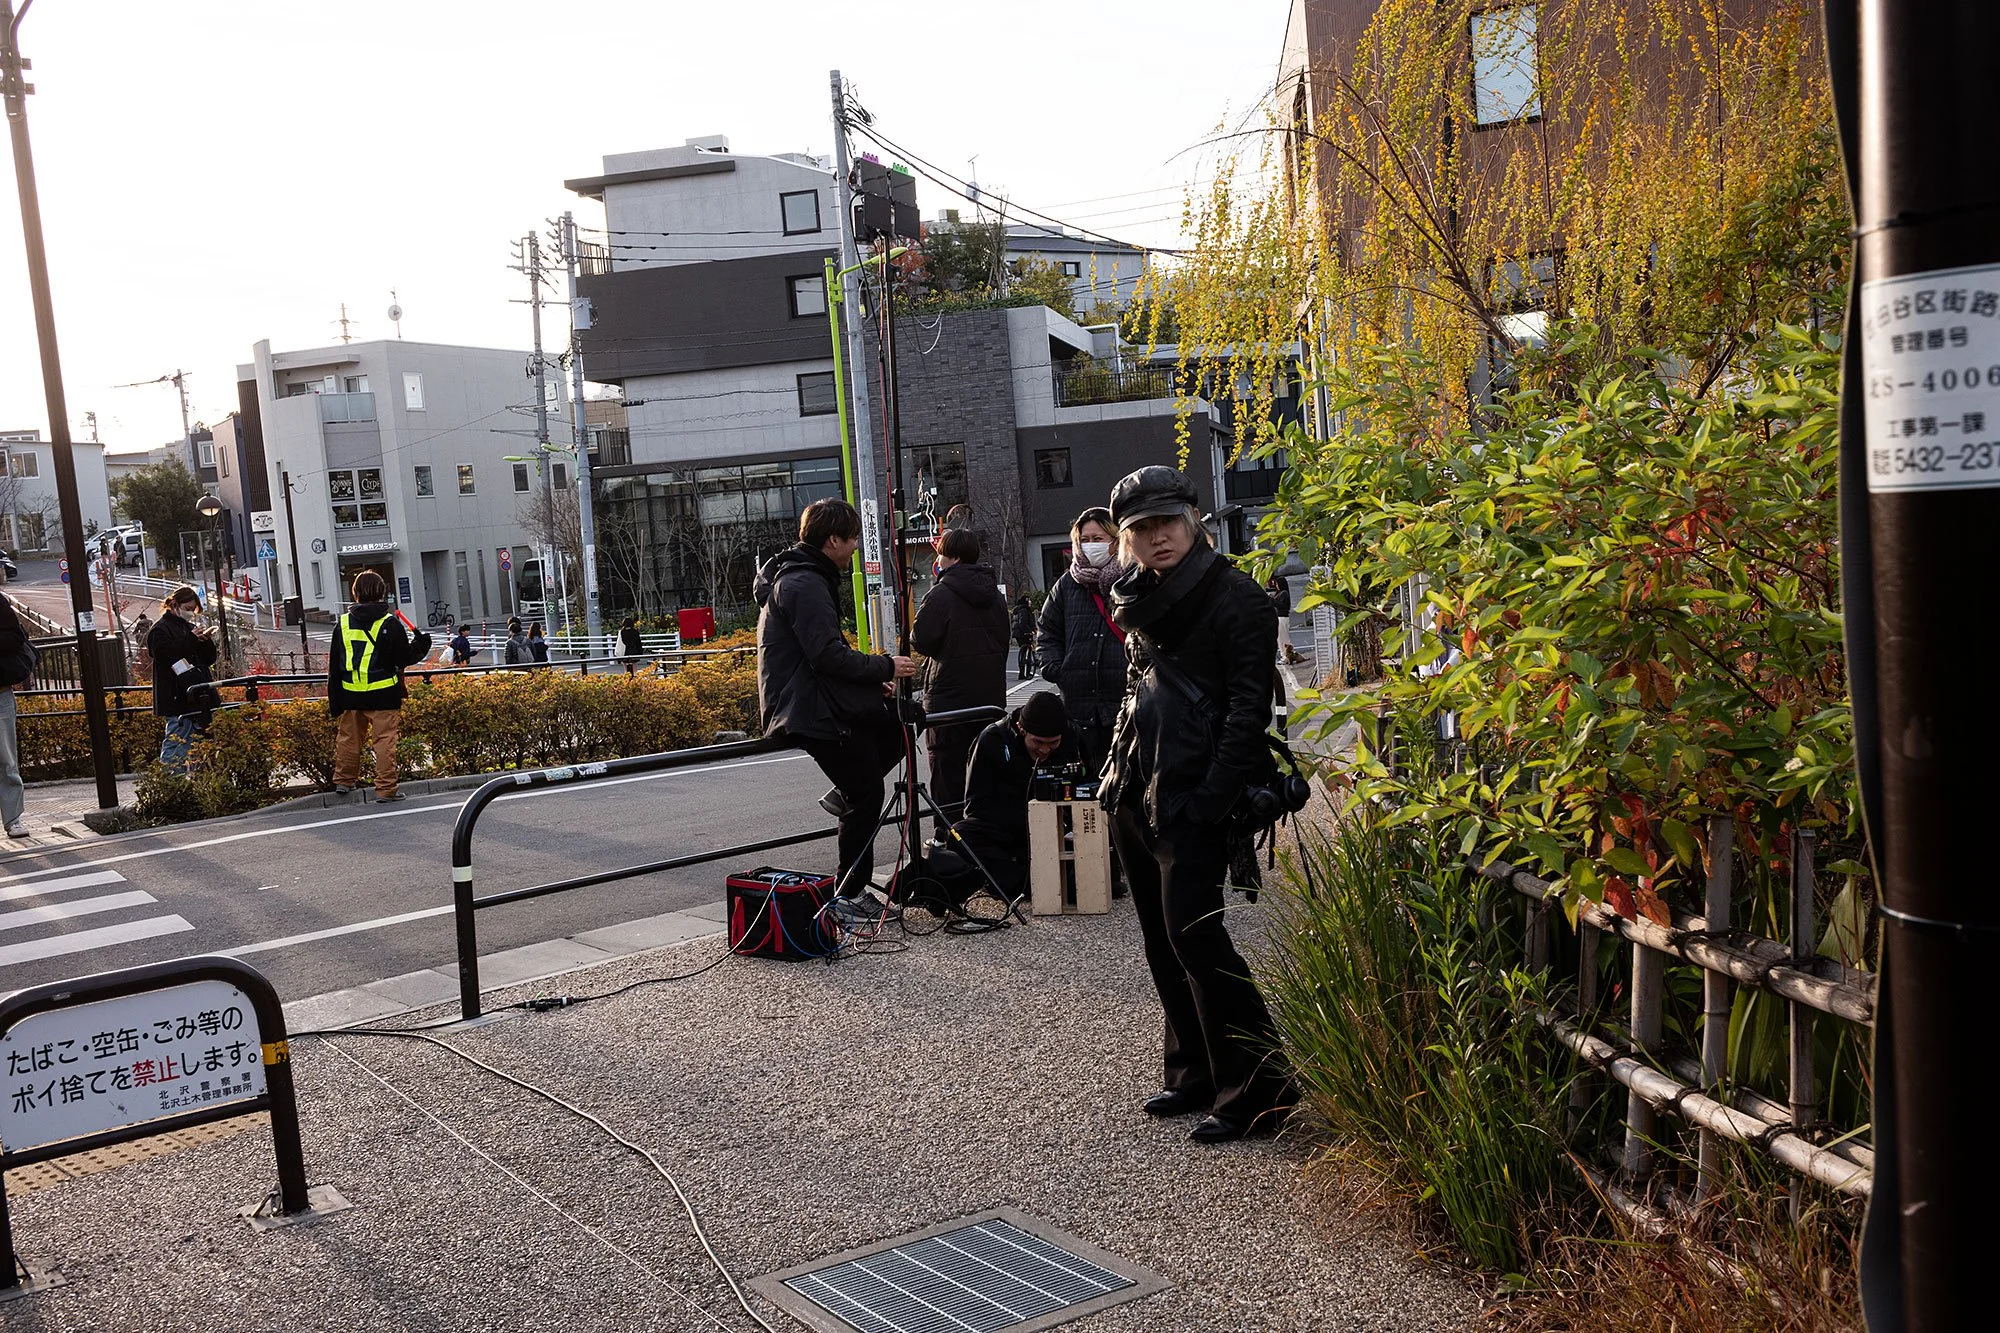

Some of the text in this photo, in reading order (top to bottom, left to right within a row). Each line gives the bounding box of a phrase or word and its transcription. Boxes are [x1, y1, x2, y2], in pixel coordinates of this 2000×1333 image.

[7, 1006, 243, 1077] たばこ・空缶・ごみ等の
[12, 1040, 258, 1115] ポイ捨てを禁止します。
[160, 1082, 253, 1110] 北沢土木管理事務所
